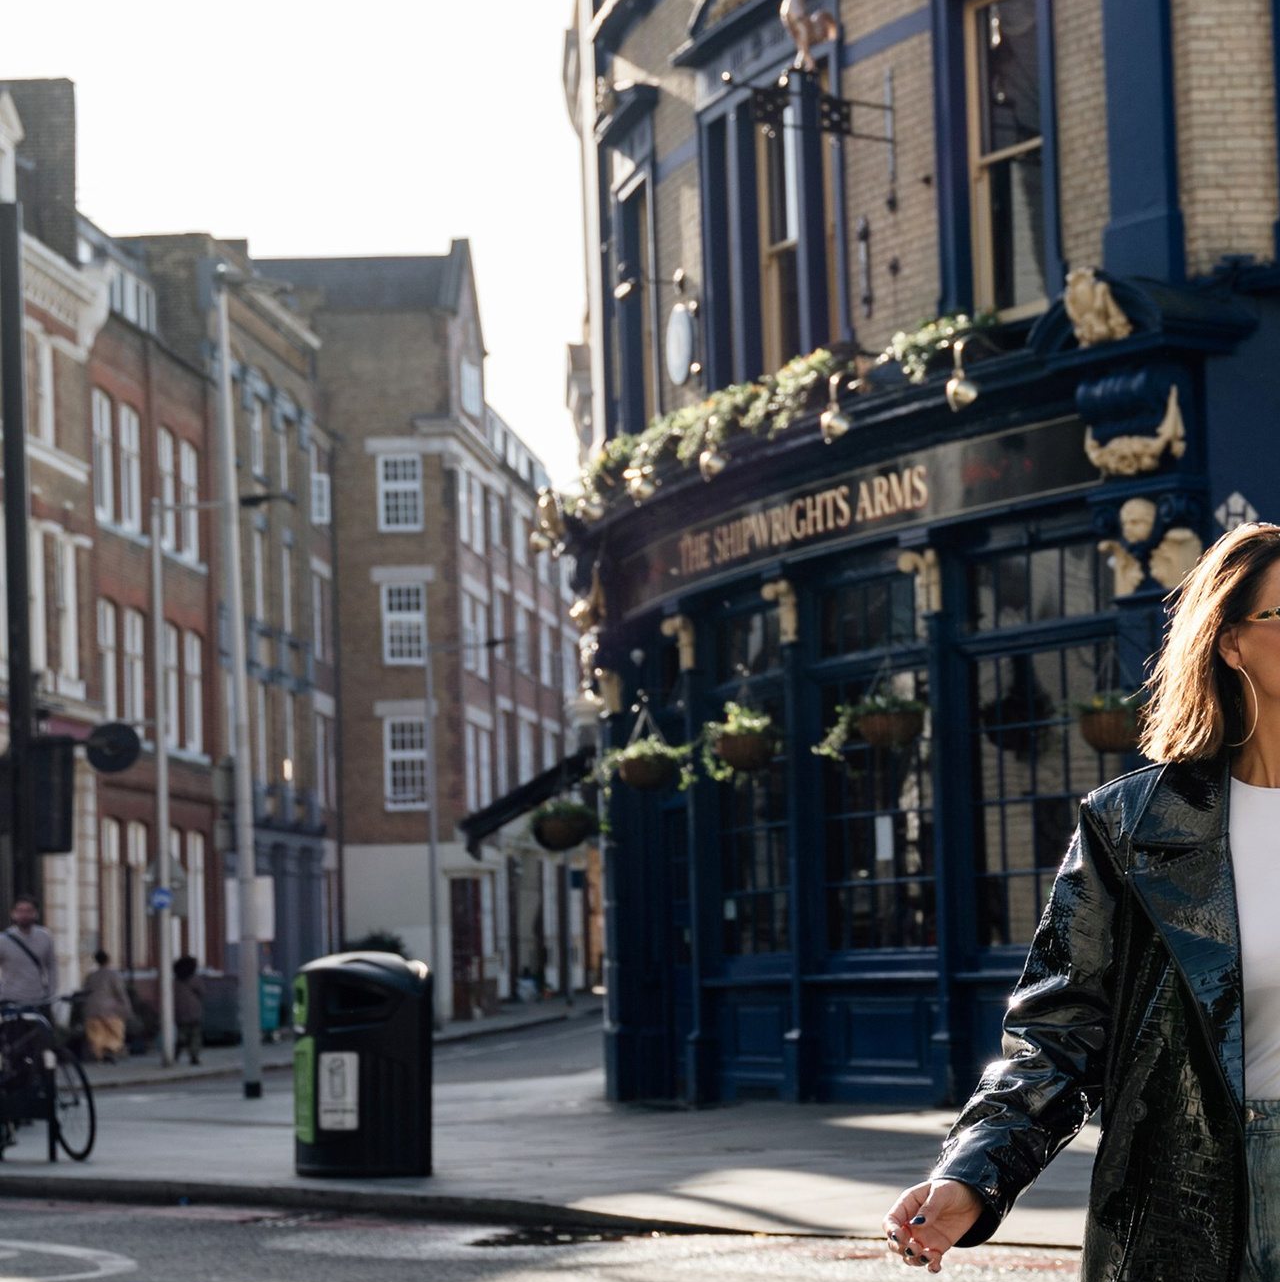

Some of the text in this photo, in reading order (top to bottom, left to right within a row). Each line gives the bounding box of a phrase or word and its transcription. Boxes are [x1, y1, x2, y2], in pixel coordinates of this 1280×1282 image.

[678, 465, 929, 575] THE SHIPWRIGHTS ARMS
